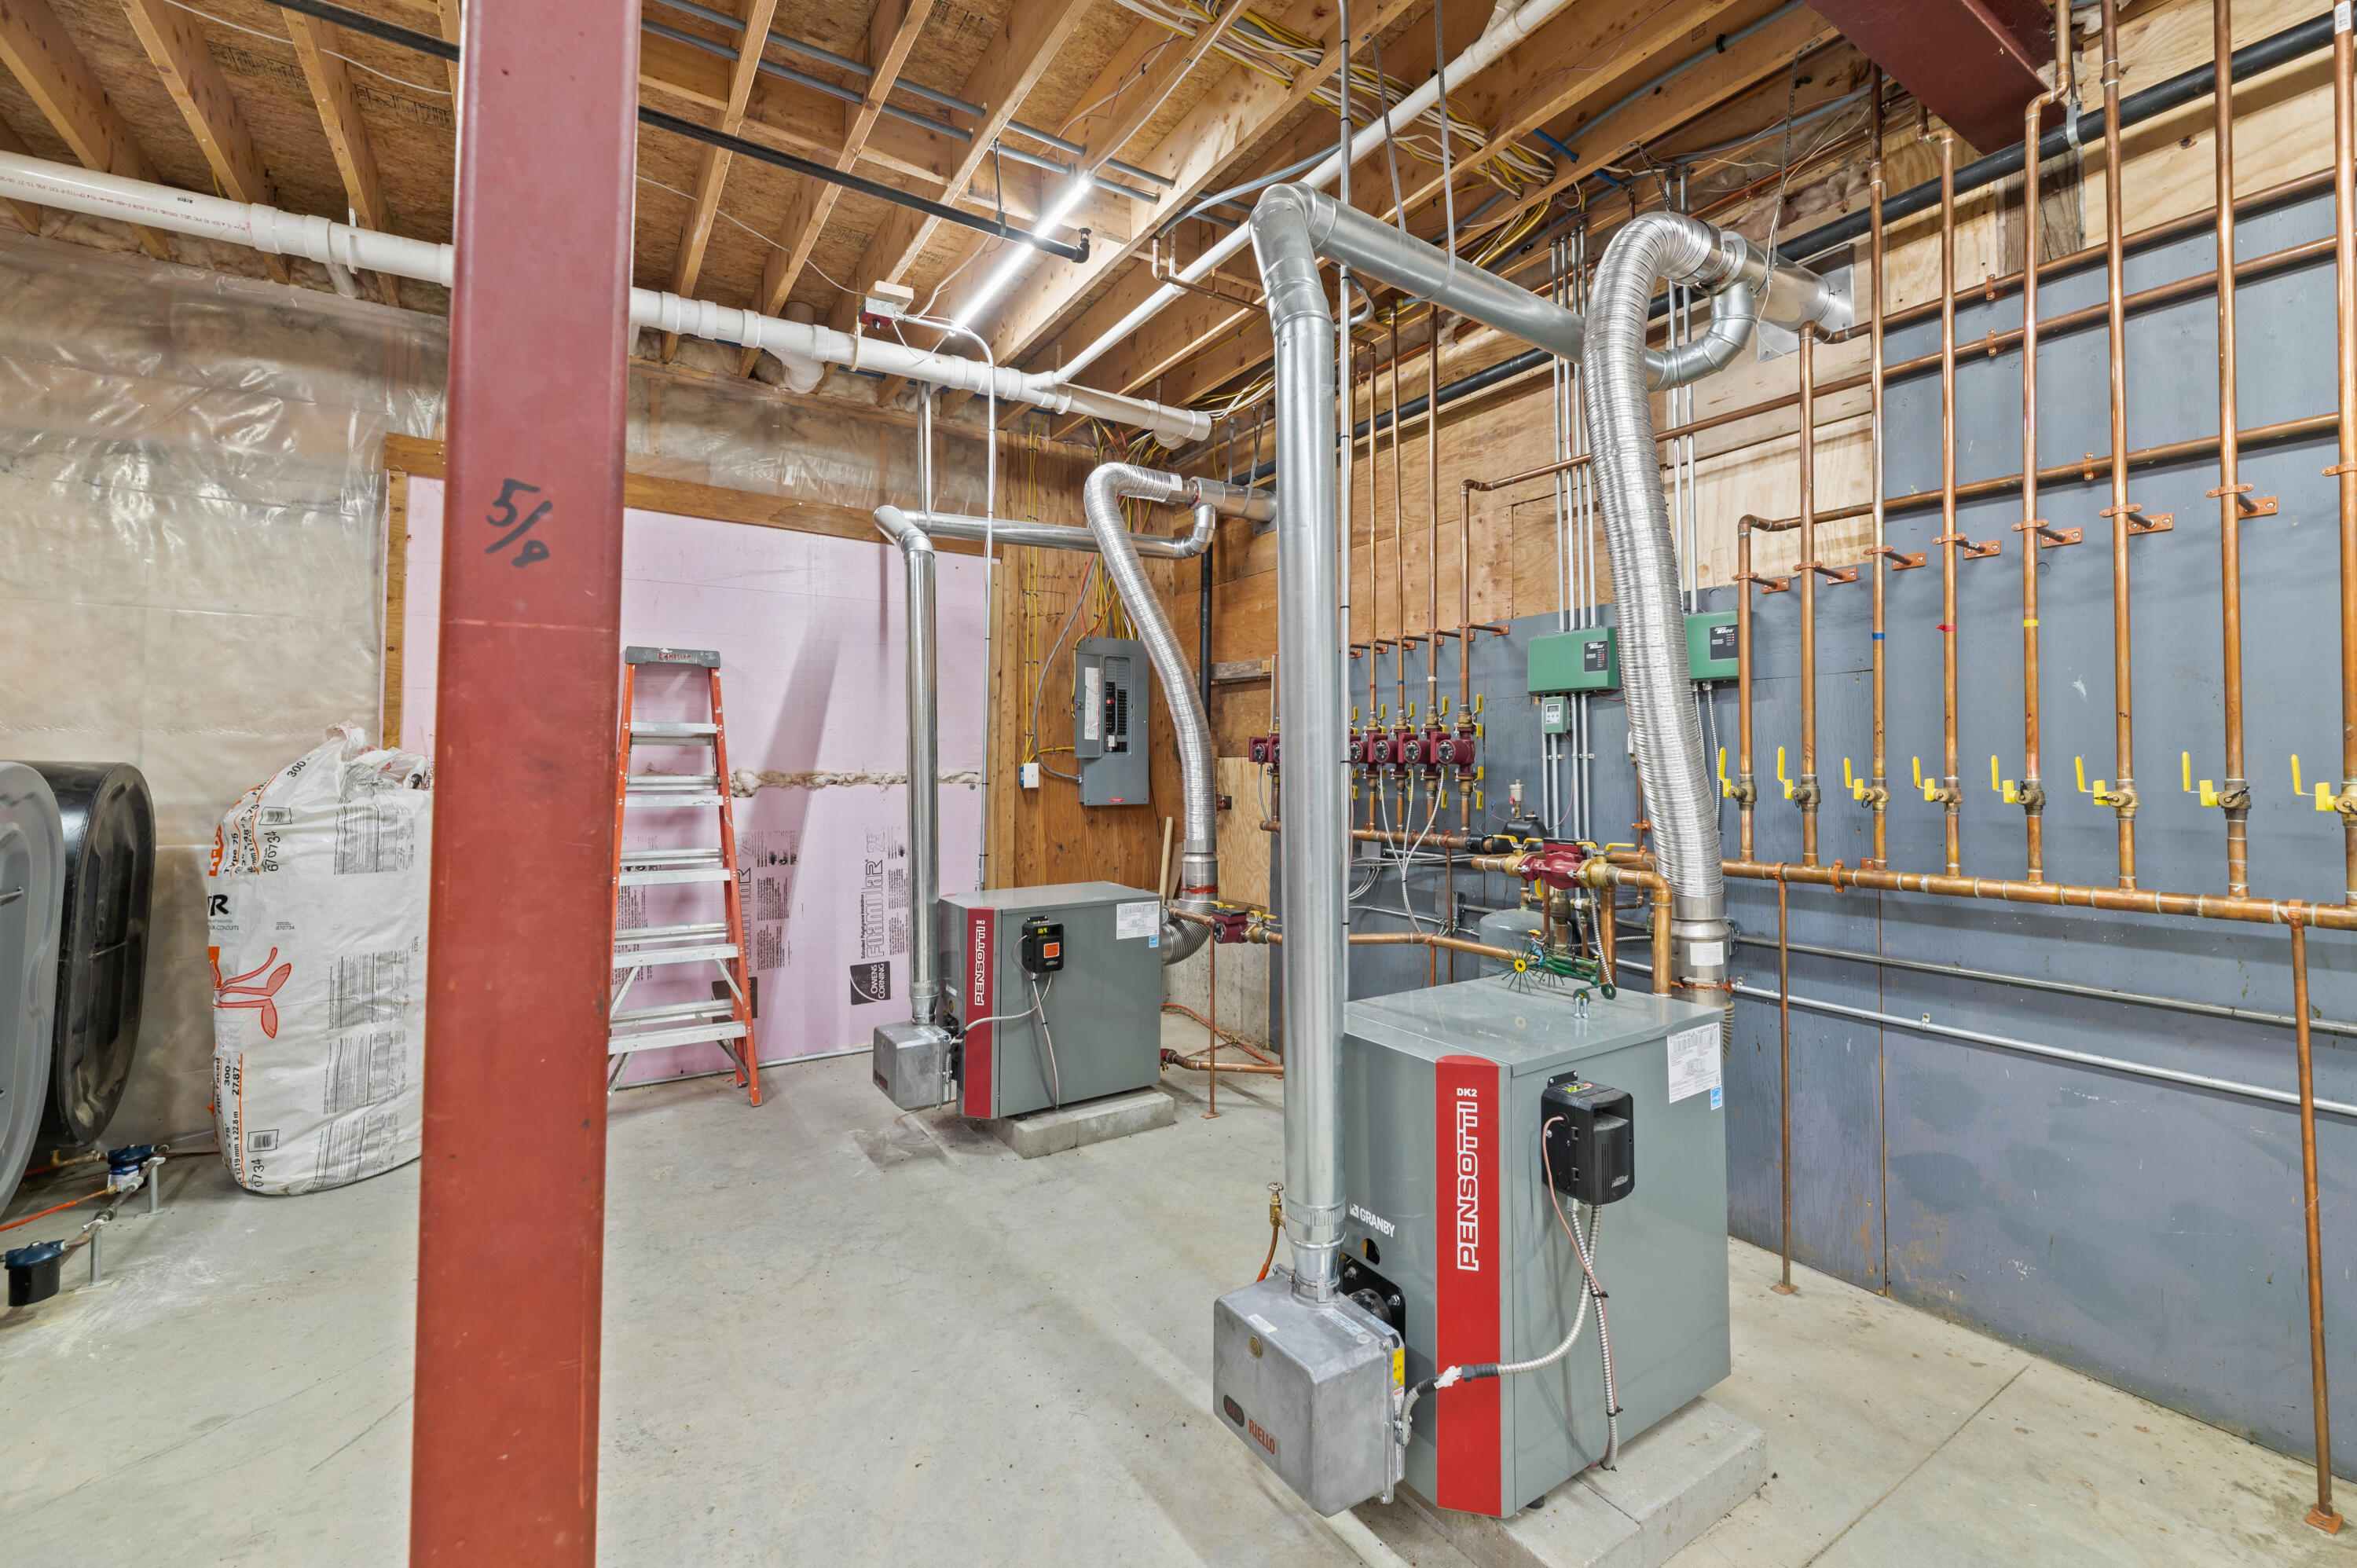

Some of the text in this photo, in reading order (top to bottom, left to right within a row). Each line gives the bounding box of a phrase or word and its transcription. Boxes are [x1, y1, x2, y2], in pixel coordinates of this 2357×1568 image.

[287, 760, 306, 778] 300
[263, 830, 281, 873] 670734
[974, 926, 985, 1006] PENSOTTI
[1457, 1087, 1478, 1097] DK2
[1457, 1101, 1479, 1272] PENSOTTI
[1360, 1207, 1395, 1238] GRANBY
[1249, 1417, 1275, 1456] RIELLO
